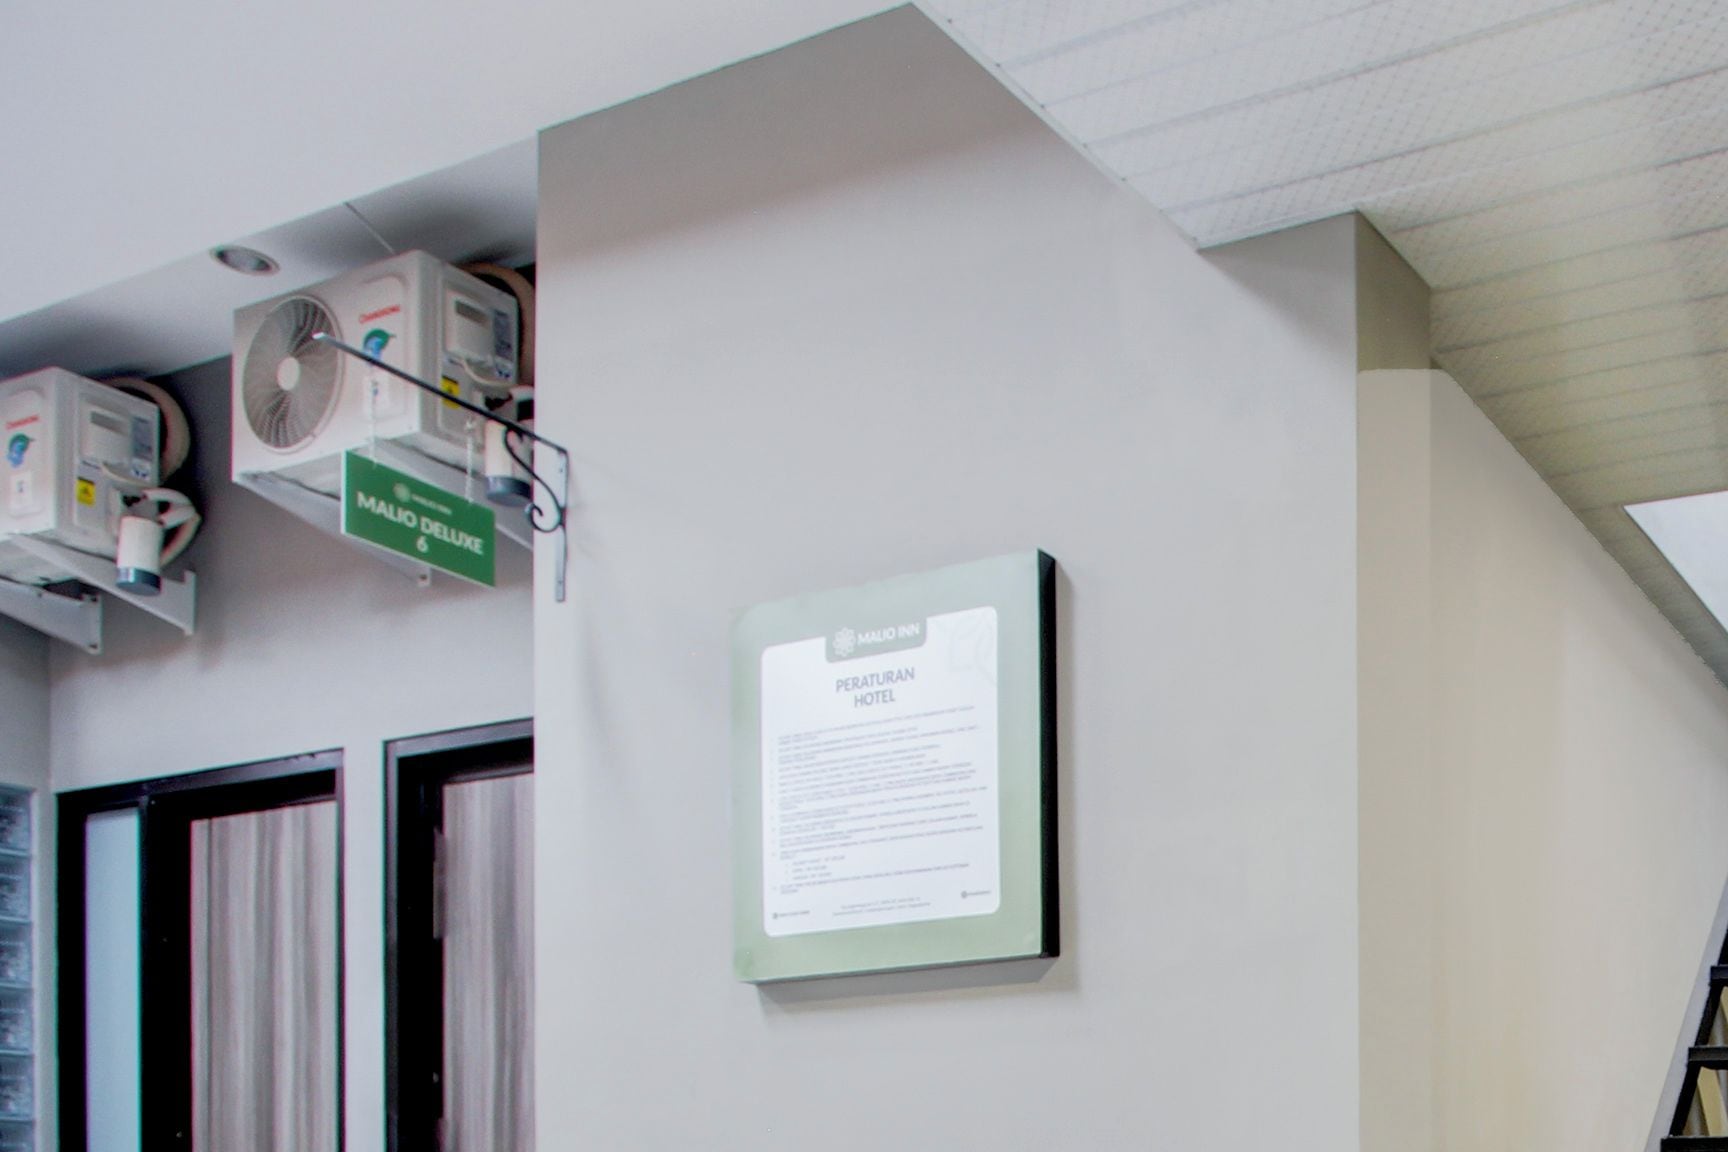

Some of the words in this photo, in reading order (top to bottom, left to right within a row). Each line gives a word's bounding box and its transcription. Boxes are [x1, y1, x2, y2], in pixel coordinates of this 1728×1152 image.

[357, 491, 417, 528] MALIO
[420, 516, 483, 555] DELUXE
[416, 535, 429, 553] 6
[898, 622, 921, 639] INN
[835, 667, 916, 693] PERATURAN
[854, 689, 896, 708] HOTEL
